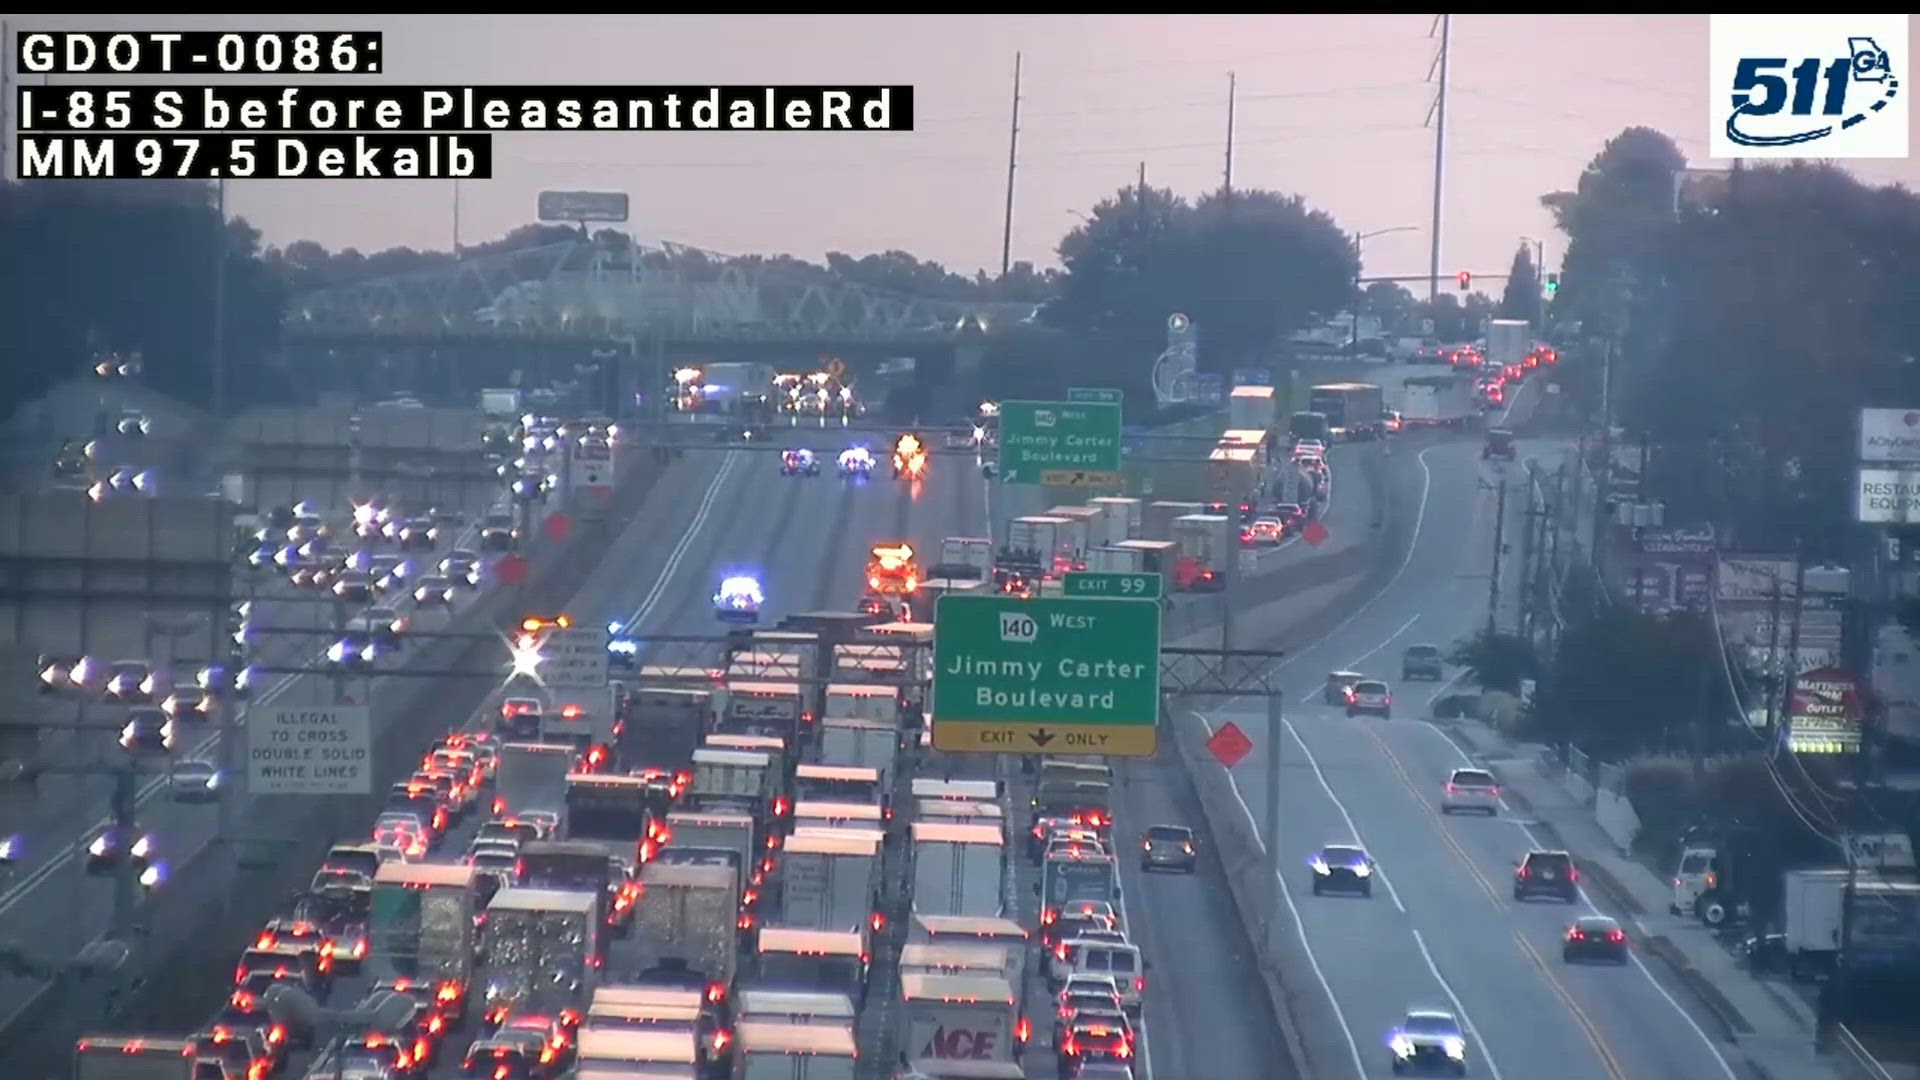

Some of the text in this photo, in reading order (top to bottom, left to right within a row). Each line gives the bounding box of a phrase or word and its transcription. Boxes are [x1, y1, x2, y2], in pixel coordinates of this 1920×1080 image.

[1007, 434, 1113, 448] Jimmy Carter
[1022, 450, 1097, 463] Boulevard
[1078, 577, 1145, 593] EXIT 99
[1002, 618, 1034, 637] 140
[947, 655, 1146, 681] Jimmy Carter
[976, 686, 1114, 709] Boulevard
[1806, 703, 1845, 713] OUTLET
[276, 712, 339, 724] ILLEGAL
[271, 730, 348, 742] TO CROSS
[980, 730, 1109, 746] EXIT ONLY
[252, 748, 366, 760] DOUBLE SOLID
[261, 766, 357, 778] WHITE LINES
[920, 1025, 998, 1059] ACE
